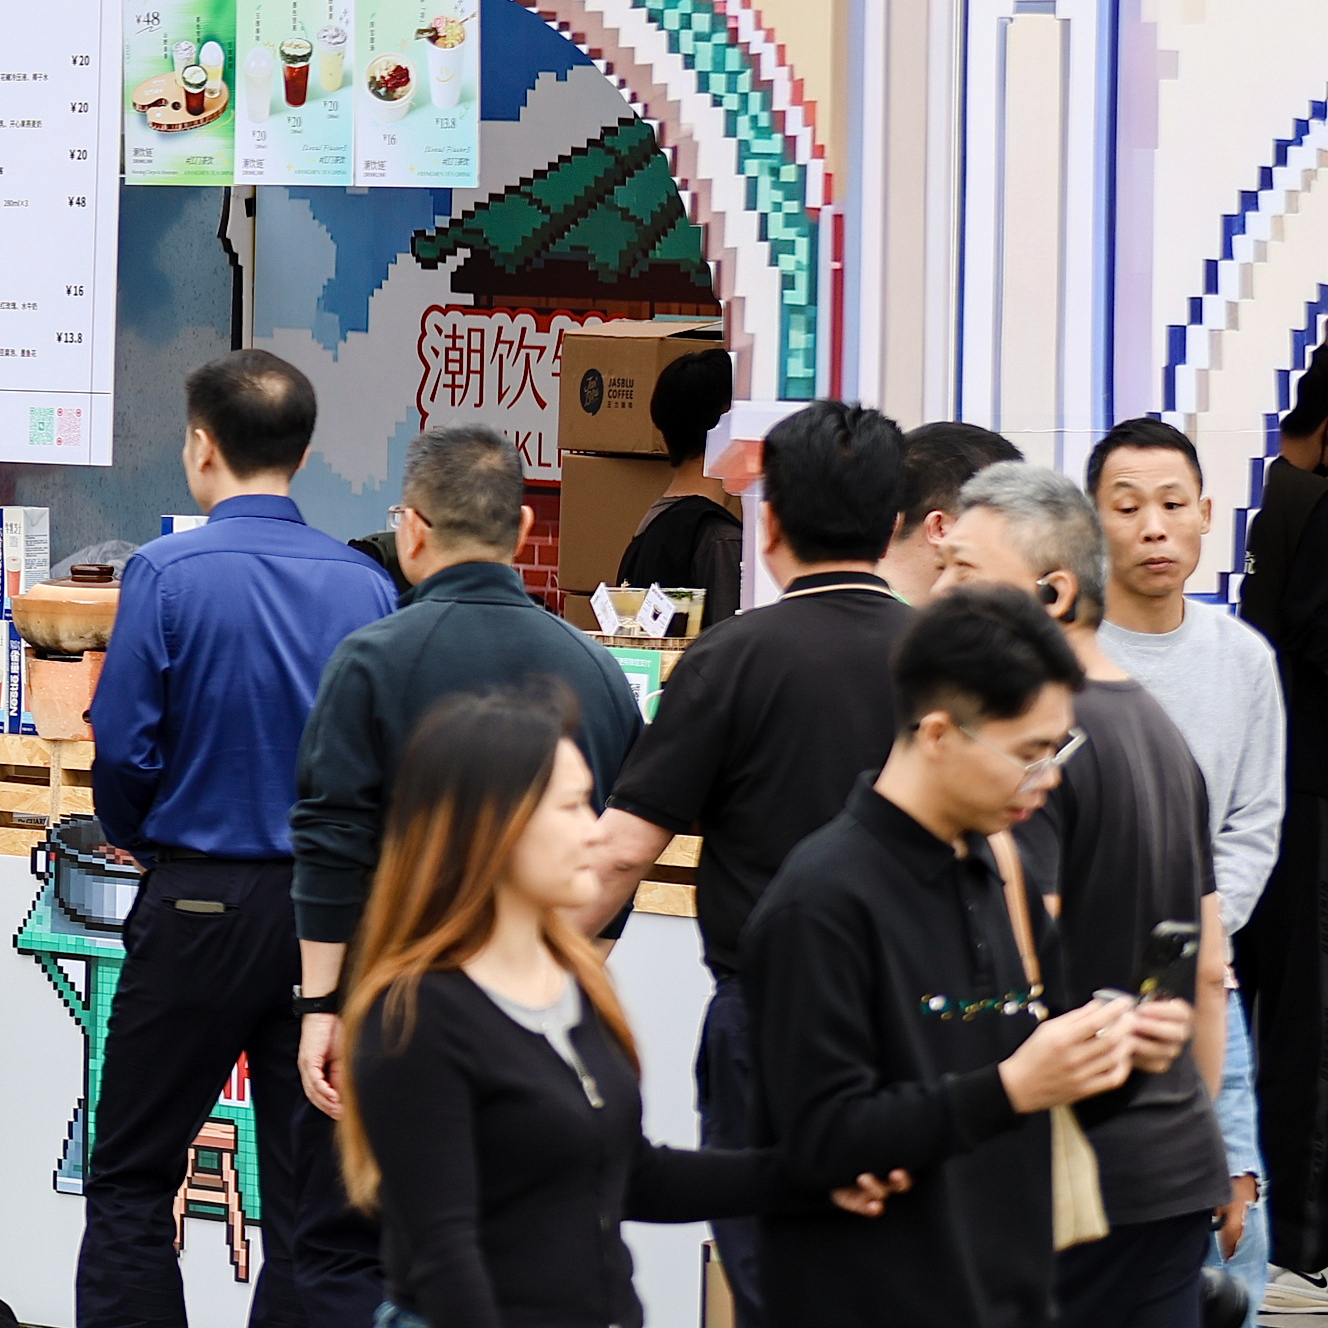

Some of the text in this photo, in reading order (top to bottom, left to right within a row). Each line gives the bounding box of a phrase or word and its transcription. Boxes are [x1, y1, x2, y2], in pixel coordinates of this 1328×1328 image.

[136, 11, 161, 26] ¥48
[71, 55, 90, 67] ¥20
[70, 101, 89, 113] ¥20
[69, 149, 87, 160] ¥20
[68, 196, 86, 207] ¥48
[66, 285, 84, 297] ¥16
[56, 332, 83, 343] ¥13.8
[608, 378, 634, 388] JASBLU
[607, 389, 634, 400] COFFEE
